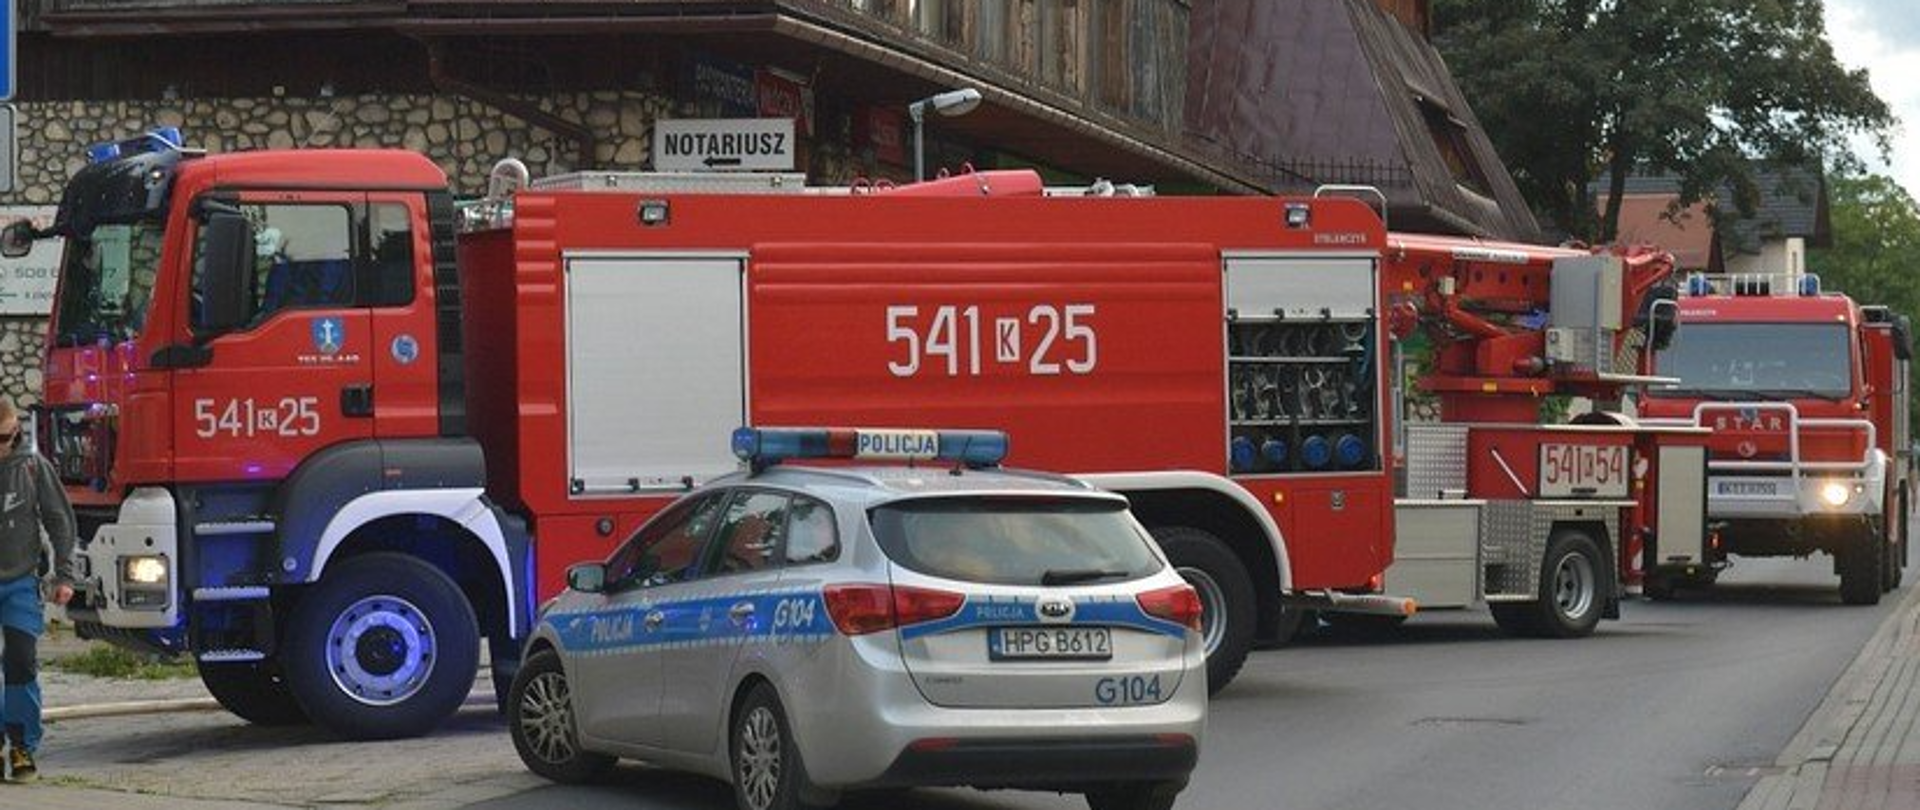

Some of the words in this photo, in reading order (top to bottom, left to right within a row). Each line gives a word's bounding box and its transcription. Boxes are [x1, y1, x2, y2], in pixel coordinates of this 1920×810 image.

[664, 132, 786, 155] NOTARIUSZ
[886, 305, 981, 377] 541
[1028, 304, 1097, 375] 25
[195, 398, 254, 437] 541
[278, 397, 320, 435] 25
[1716, 417, 1782, 430] STAR
[860, 433, 935, 453] POLICJA
[1546, 444, 1582, 485] 541
[1596, 446, 1623, 485] 54
[774, 598, 815, 627] G104
[976, 607, 1025, 619] POLICJA
[1004, 631, 1049, 652] HPG
[1056, 630, 1107, 652] B612
[1095, 674, 1161, 703] G104
